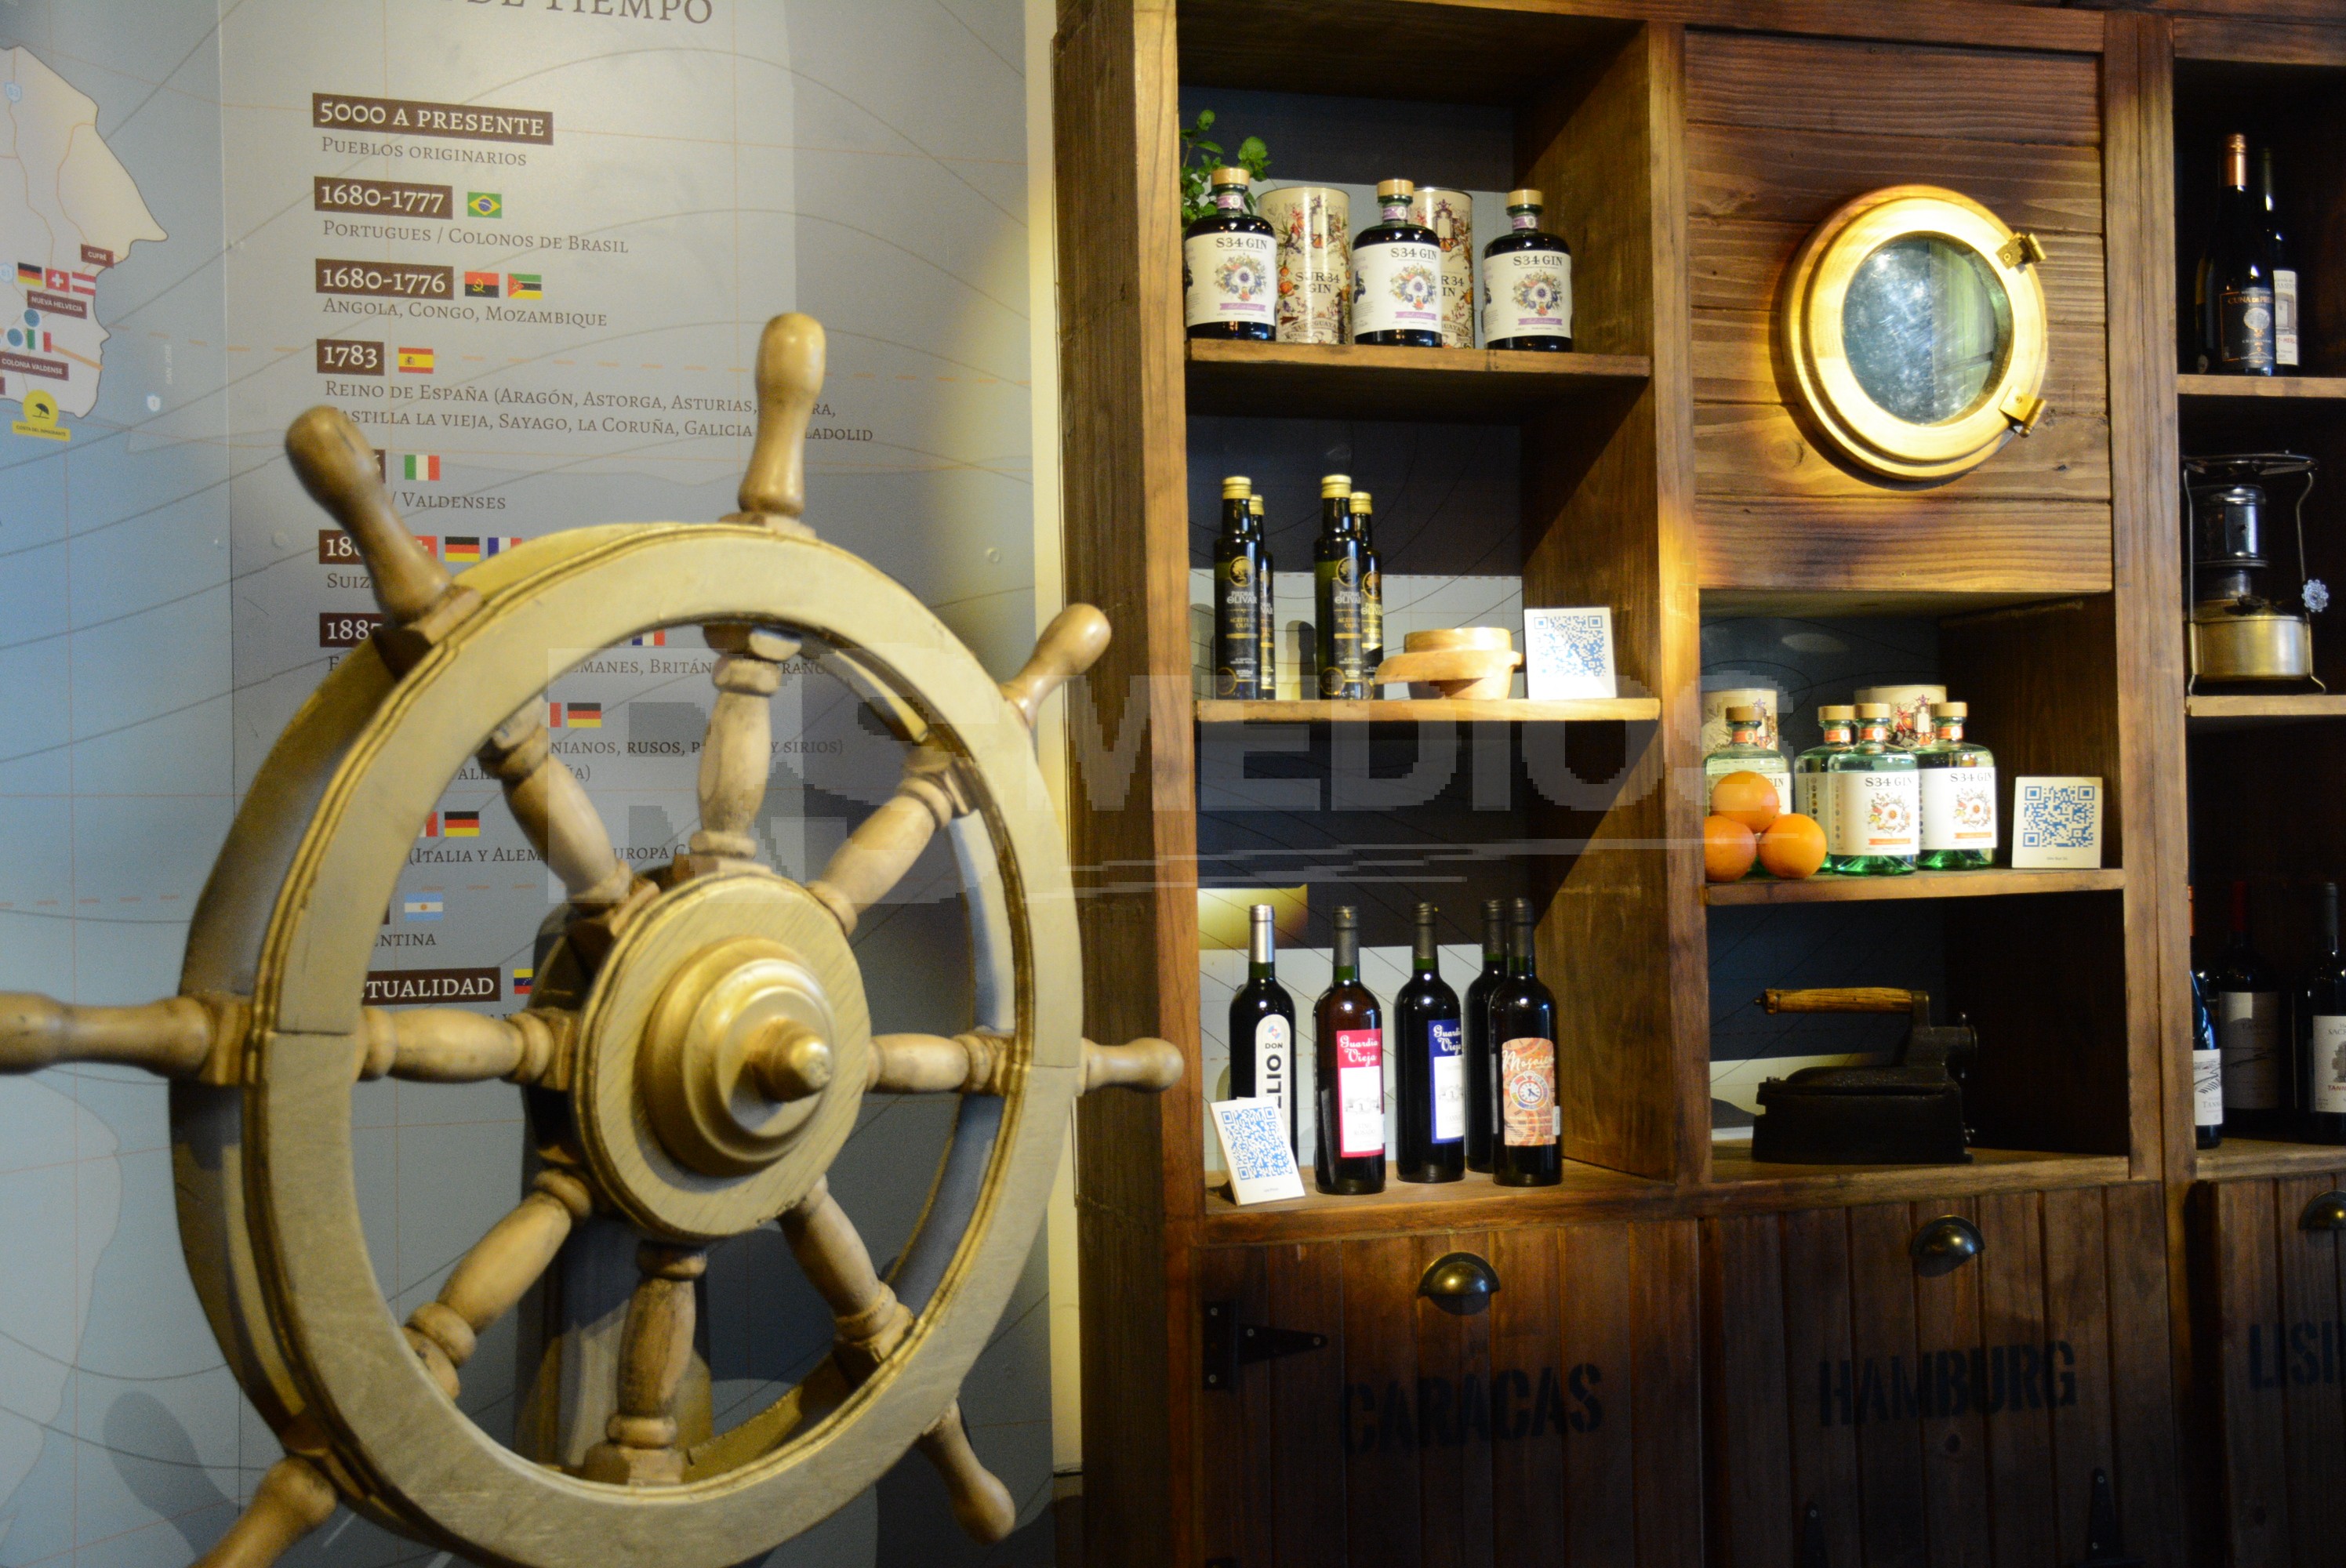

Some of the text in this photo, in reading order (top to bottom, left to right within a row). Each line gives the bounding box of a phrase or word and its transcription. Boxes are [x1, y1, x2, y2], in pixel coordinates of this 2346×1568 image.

[320, 100, 544, 136] 5000 A PRESENTE
[321, 136, 527, 166] PUEBLOS ORIGINARIOS
[321, 183, 445, 214] 1680-1777
[323, 220, 629, 254] PORTUGUES / COLONOS DE BRASIL
[1216, 238, 1267, 249] S34 GIN
[1390, 248, 1437, 260] S34 GIN
[1513, 256, 1563, 266] S34 GIN
[322, 266, 446, 294] 1680-1776
[1309, 284, 1331, 293] GIN
[1443, 287, 1455, 297] IN
[31, 296, 83, 312] NUEVA HELVECIA
[323, 297, 607, 328] ANGOLA, CONGO, MOZAMBIQUE
[323, 345, 378, 369] 1783
[2, 358, 64, 375] COLONIA VALDENSE
[325, 380, 757, 415] REINO DE ESPAÑA (ARAGÓN, ASTORGA, ASTURIAS,
[416, 413, 436, 426] LA
[441, 414, 493, 430] VIEJA,
[499, 413, 572, 433] SAYAGO,
[578, 419, 597, 431] LA
[602, 417, 679, 437] CORUÑA,
[685, 420, 753, 437] GALICIA
[805, 428, 873, 441] LADOLID
[401, 492, 506, 509] VALDENSES
[326, 536, 359, 557] 18
[327, 573, 371, 589] SUIZ
[650, 658, 713, 674] BRITÁN
[550, 742, 621, 757] NIANOS,
[626, 741, 686, 757] RUSOS,
[783, 740, 843, 756] SIRIOS)
[1865, 777, 1912, 787] S34 GIN
[1950, 773, 1974, 782] S34
[409, 845, 470, 866] (ITALIA
[478, 850, 488, 862] Y
[492, 847, 546, 864] ALEM
[615, 845, 670, 861] UROPA
[376, 934, 437, 947] NTINA
[365, 978, 495, 999] TUALIDAD
[1340, 1035, 1378, 1048] Guardia
[1345, 1047, 1377, 1066] Vieja
[1818, 1340, 2076, 1427] HAMBURG
[1339, 1363, 1603, 1457] CARACAS
